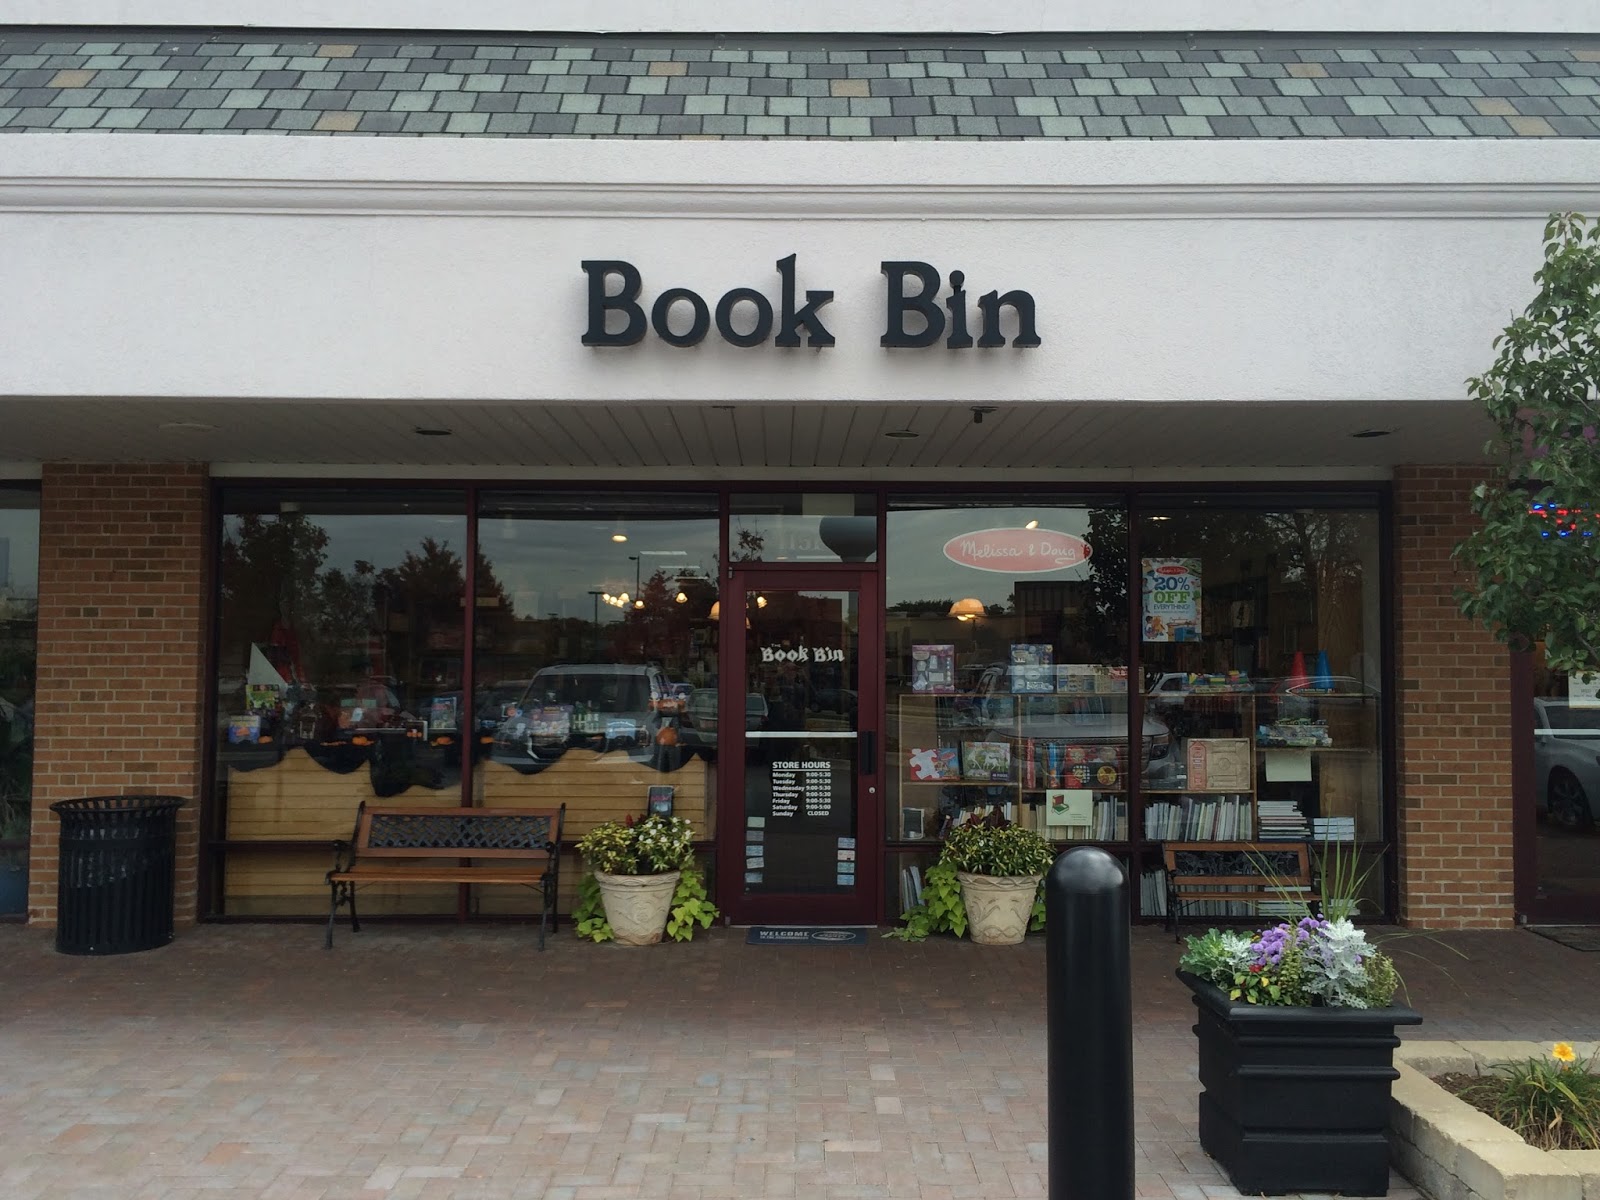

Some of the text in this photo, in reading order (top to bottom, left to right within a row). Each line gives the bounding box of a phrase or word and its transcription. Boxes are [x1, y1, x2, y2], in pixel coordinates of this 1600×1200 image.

[580, 253, 1042, 349] Book Bin
[960, 540, 1023, 561] Melissa
[1040, 541, 1076, 564] Doug
[1153, 577, 1190, 590] 20%
[1153, 591, 1190, 603] OFF
[760, 645, 845, 662] Book Bin
[772, 761, 831, 769] STORE HOURS
